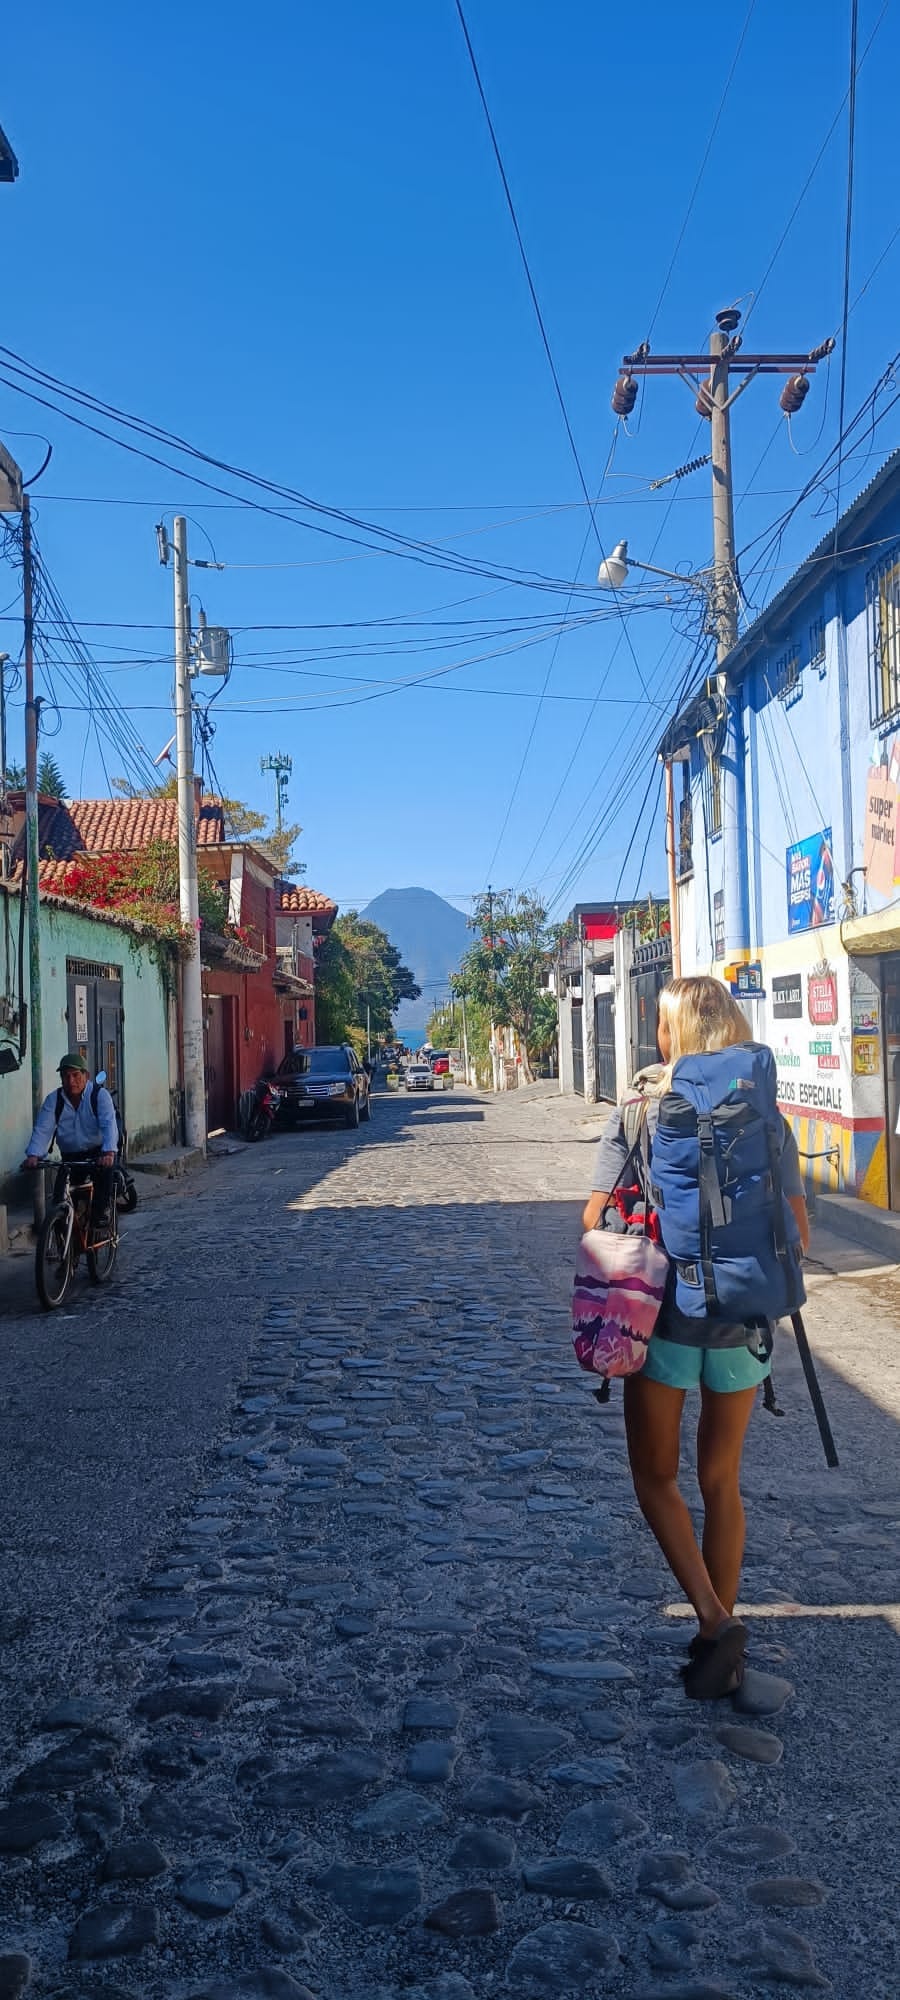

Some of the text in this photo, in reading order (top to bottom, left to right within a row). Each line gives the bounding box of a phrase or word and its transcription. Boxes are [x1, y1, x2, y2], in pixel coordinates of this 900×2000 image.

[869, 796, 893, 820] super
[871, 821, 895, 847] market
[812, 983, 833, 999] STELLA
[777, 1081, 795, 1101] ECIOS
